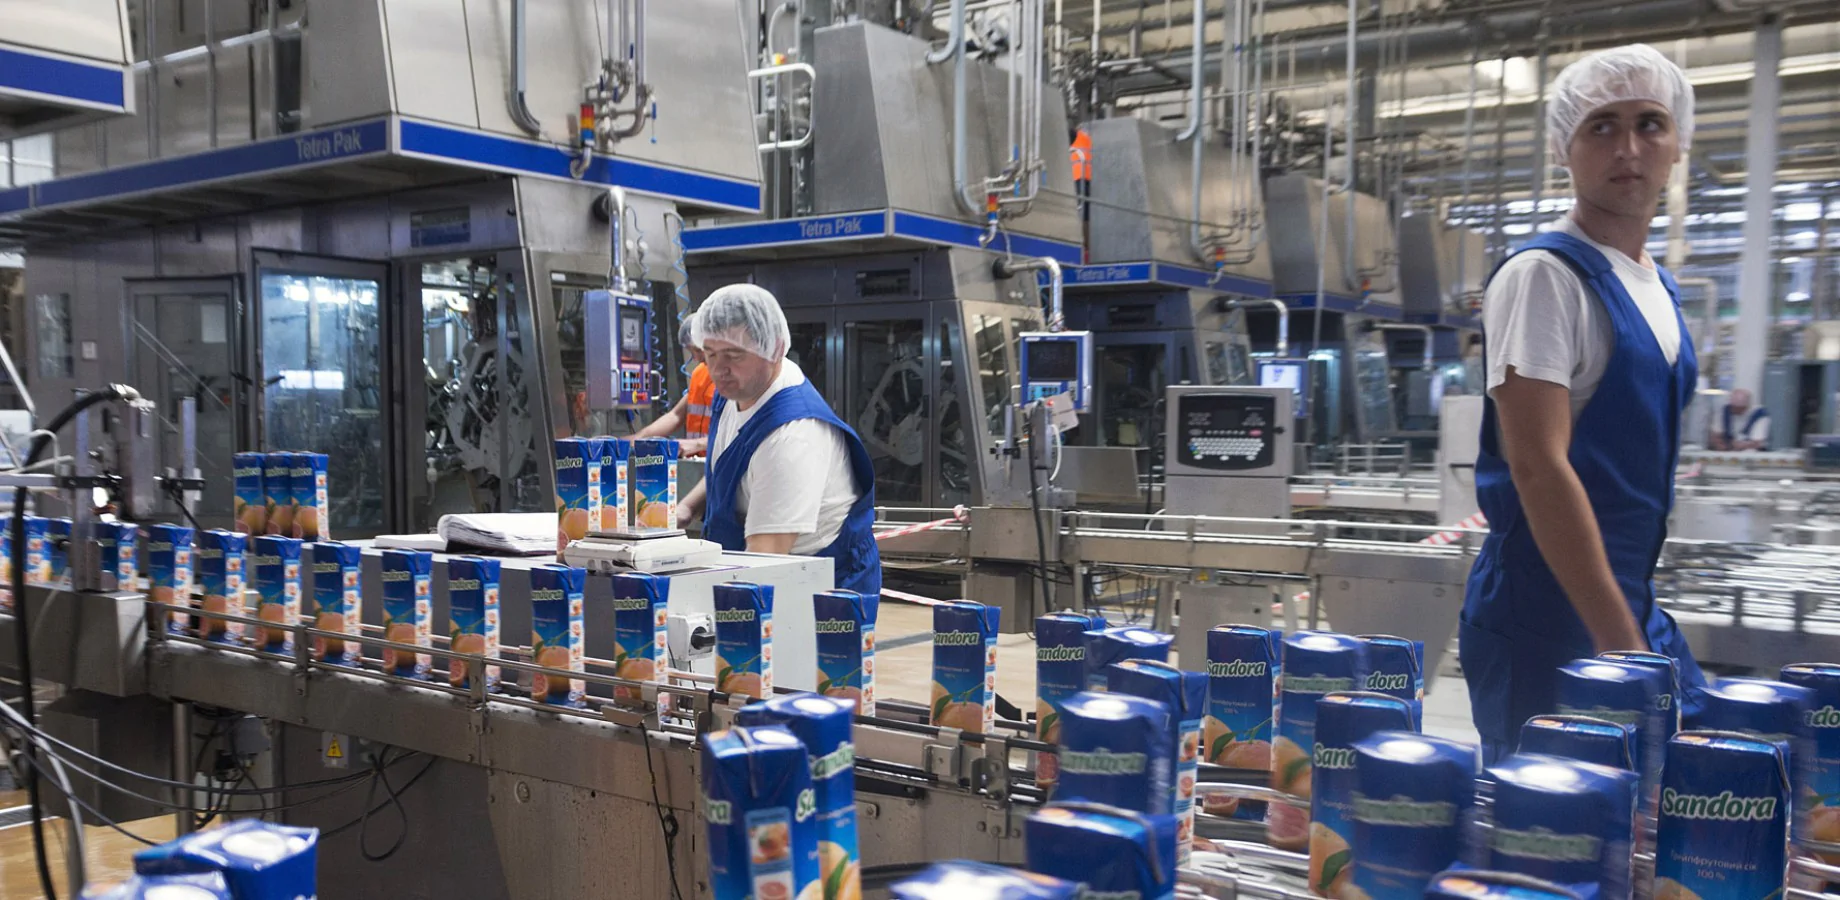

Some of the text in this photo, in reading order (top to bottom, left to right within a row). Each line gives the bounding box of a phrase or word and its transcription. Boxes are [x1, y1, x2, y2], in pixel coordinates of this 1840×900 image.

[295, 130, 362, 160] Tetra Pak
[799, 218, 862, 237] Tetra Pak
[1074, 267, 1130, 281] Tetra Pak
[716, 607, 755, 622] andora
[1037, 644, 1086, 661] andora
[1366, 670, 1408, 690] dora
[1662, 787, 1777, 821] Sandora
